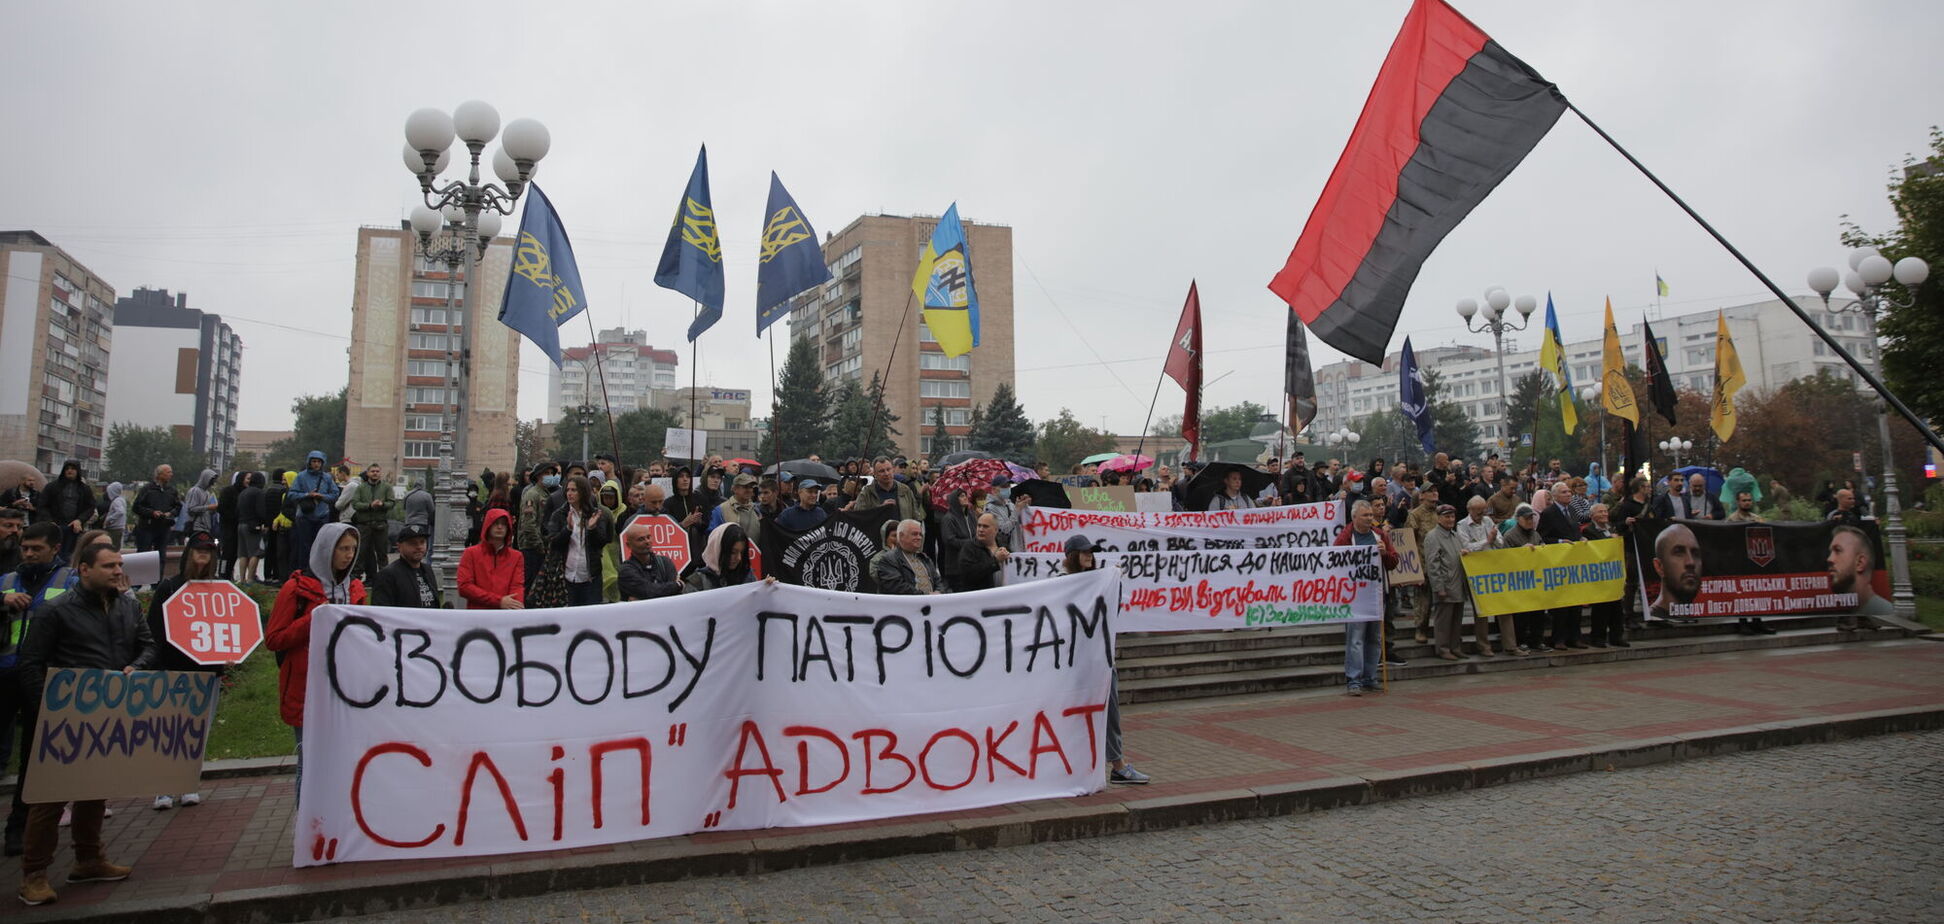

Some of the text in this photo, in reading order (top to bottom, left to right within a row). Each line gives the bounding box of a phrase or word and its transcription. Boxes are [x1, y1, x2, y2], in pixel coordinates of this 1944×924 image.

[1270, 551, 1324, 575] НАШИХ
[182, 592, 242, 617] STOP
[190, 621, 242, 654] ЗЕ!
[327, 615, 716, 712] СВОБОДУ
[45, 669, 217, 717] СВОБОДУ
[38, 713, 206, 765] КУХАРЧУКУ
